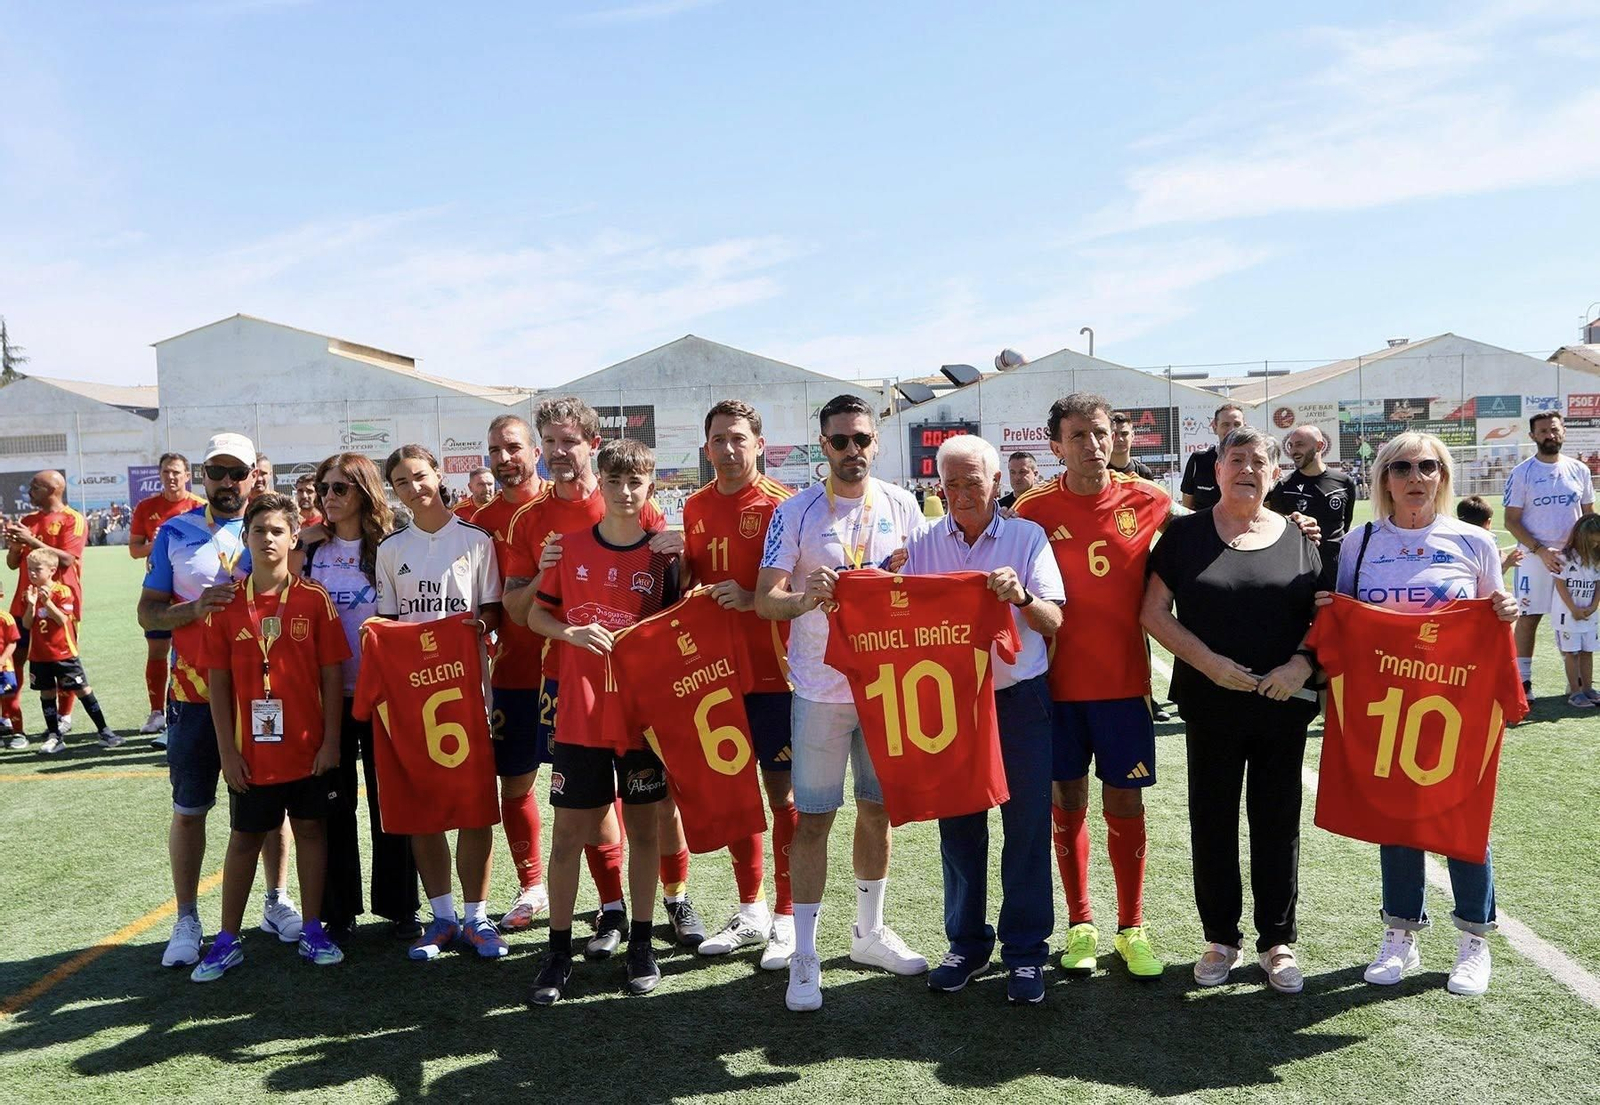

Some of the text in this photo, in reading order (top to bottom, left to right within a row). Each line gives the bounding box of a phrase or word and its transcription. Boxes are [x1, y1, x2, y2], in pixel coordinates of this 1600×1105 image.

[1569, 396, 1594, 407] PSOE
[922, 459, 933, 475] 0
[78, 475, 117, 485] AGUSE
[1533, 492, 1580, 507] COTEX
[706, 536, 729, 571] 11
[1088, 540, 1111, 577] 6
[418, 580, 441, 595] Fly
[1520, 576, 1531, 594] 4
[1566, 578, 1596, 589] Emira
[39, 619, 48, 634] 2
[409, 660, 465, 688] SELENA
[672, 658, 735, 699] SAMUEL
[865, 659, 959, 757] 10
[422, 687, 470, 768] 6
[693, 687, 752, 777] 6
[1366, 686, 1463, 787] 10
